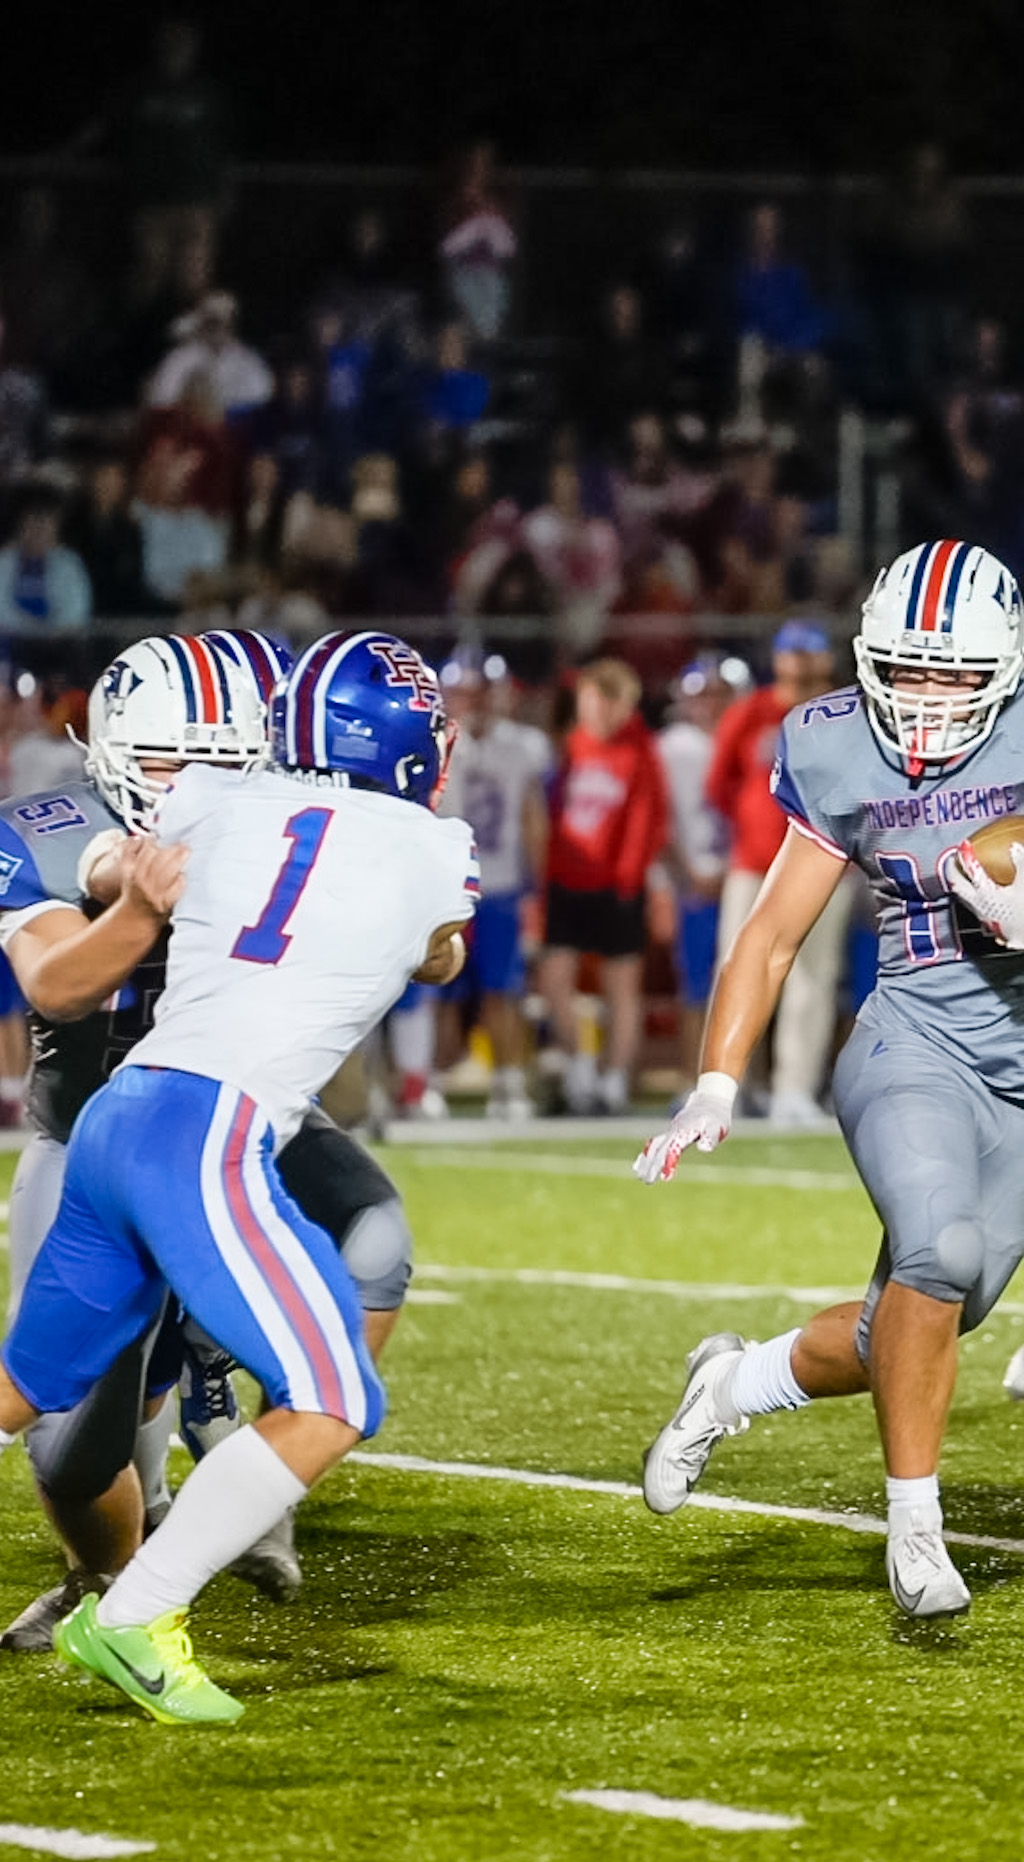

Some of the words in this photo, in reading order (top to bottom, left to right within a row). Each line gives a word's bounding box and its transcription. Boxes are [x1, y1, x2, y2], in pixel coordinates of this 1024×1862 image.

[800, 685, 862, 728] 12
[14, 795, 90, 836] 51
[866, 785, 1018, 830] NDEPENDENCE
[229, 806, 336, 967] 1
